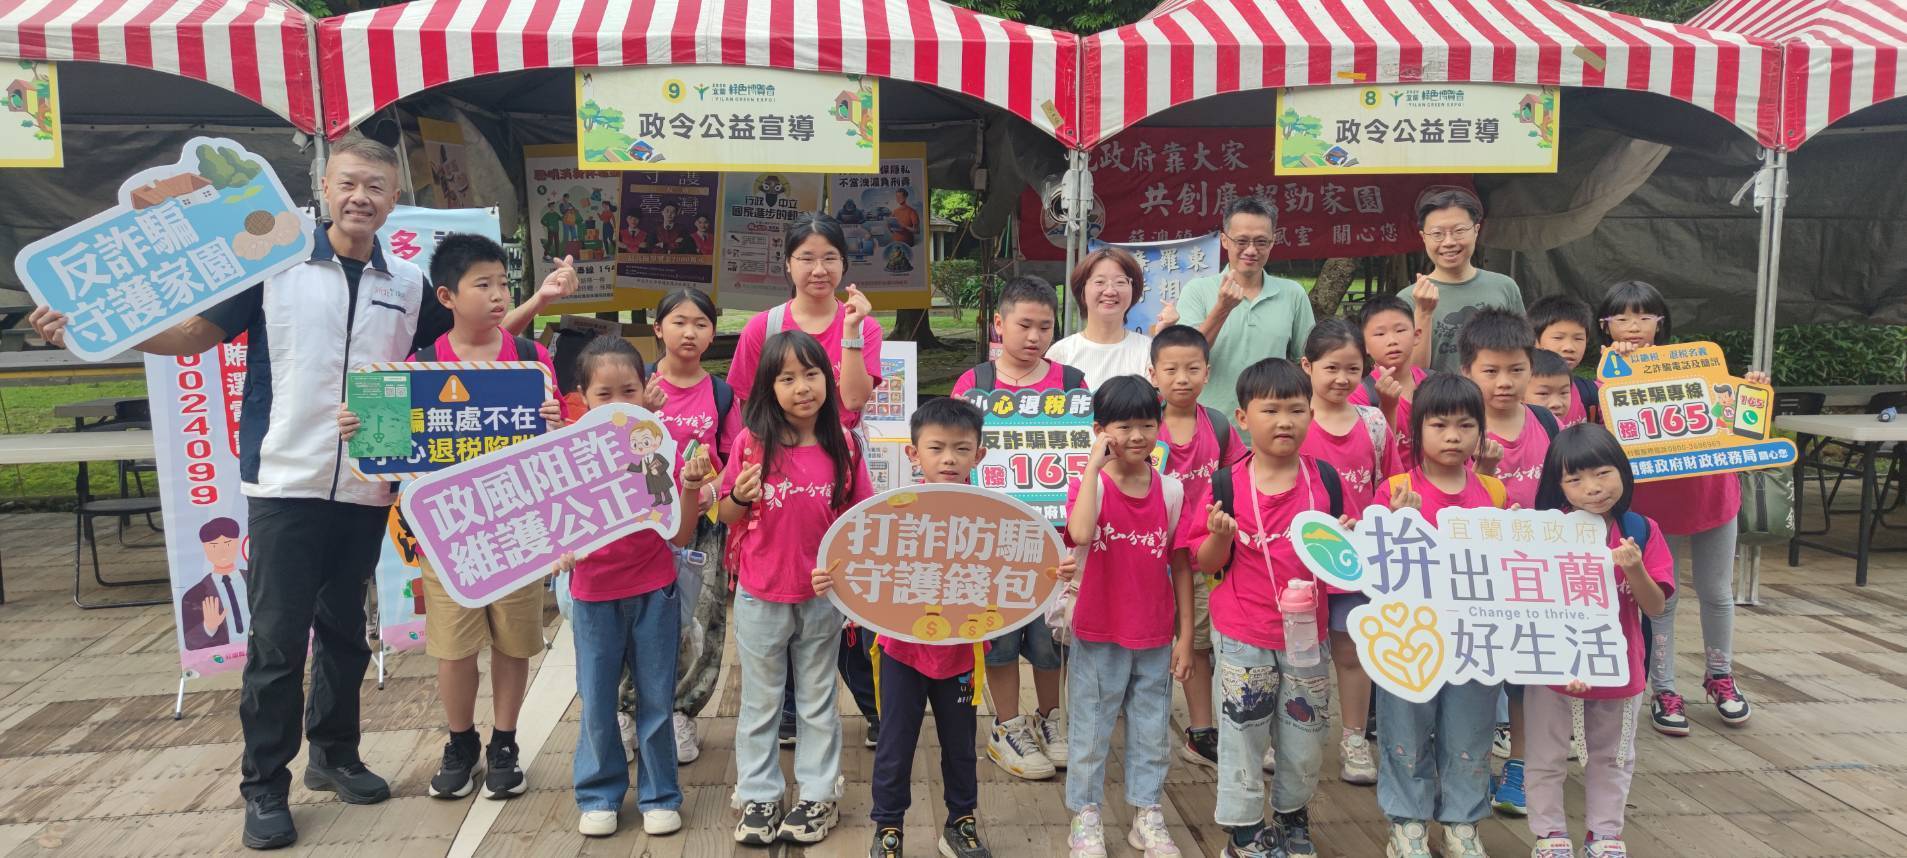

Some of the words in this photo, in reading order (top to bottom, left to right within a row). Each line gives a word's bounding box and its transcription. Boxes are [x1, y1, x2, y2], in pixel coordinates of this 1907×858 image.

[669, 83, 680, 98] 9
[1365, 91, 1377, 106] 8
[639, 112, 816, 142] 政令公益宣導
[1335, 118, 1500, 145] 政令公益宣導
[1333, 223, 1399, 245] 關心您
[47, 200, 200, 301] 反詐騙
[67, 236, 247, 343] 守護家園
[1612, 382, 1705, 408] 反詐騙專線
[1740, 395, 1764, 409] 165
[982, 430, 1091, 450] 反詐騙專線
[423, 430, 626, 542] 政風阻詐
[449, 473, 651, 588] 維護公正
[846, 510, 1046, 564] 打詐防騙
[1447, 517, 1599, 546] 宜蘭縣政府
[845, 559, 1039, 610] 守護錢包
[1469, 606, 1521, 621] Change
[1526, 608, 1540, 619] to
[1545, 608, 1590, 621] thrive.
[1450, 618, 1620, 678] 好生活
